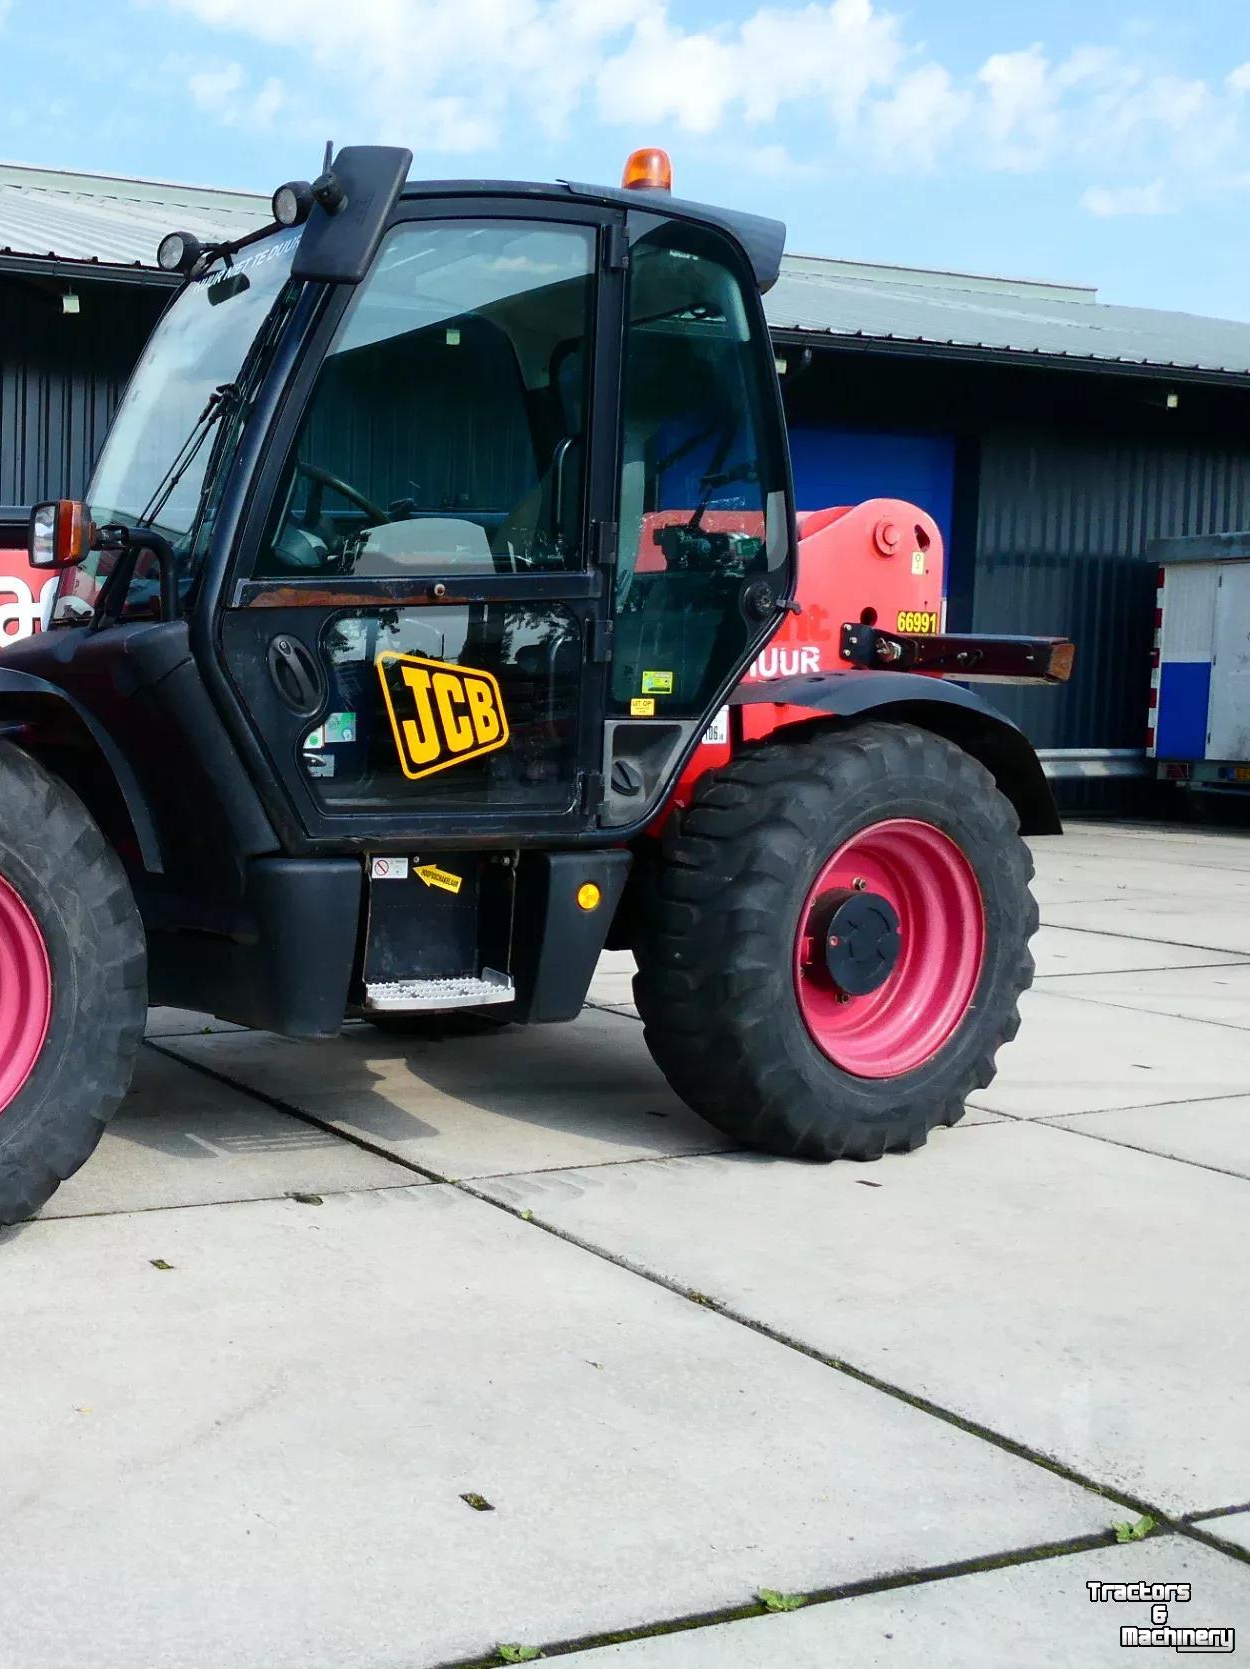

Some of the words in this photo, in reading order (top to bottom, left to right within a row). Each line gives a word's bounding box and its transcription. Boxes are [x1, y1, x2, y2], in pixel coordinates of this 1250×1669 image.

[251, 249, 270, 268] TE
[897, 611, 937, 633] 66991
[401, 666, 500, 765] JCB
